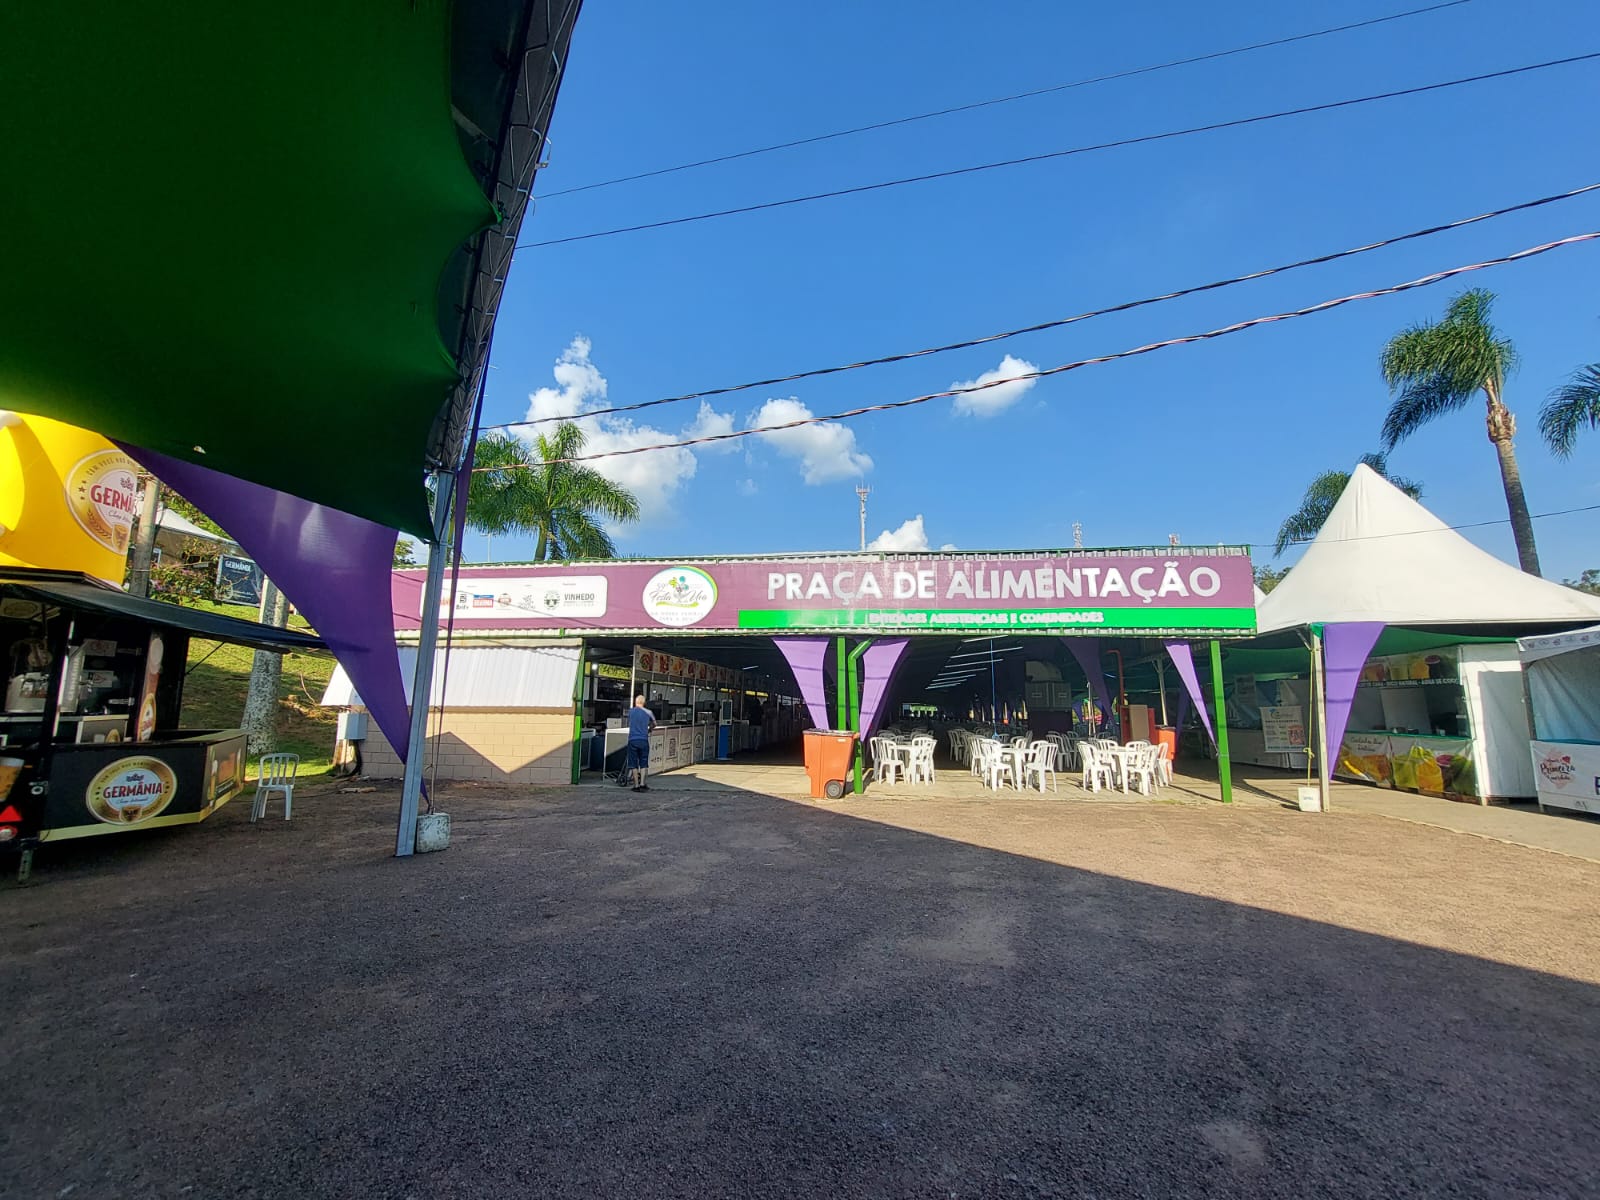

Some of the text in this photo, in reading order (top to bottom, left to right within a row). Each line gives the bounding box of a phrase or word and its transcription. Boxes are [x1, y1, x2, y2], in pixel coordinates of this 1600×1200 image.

[767, 561, 1221, 605] PRAÇA DE ALIMENTAÇÃO
[564, 593, 595, 601] VINHEDO
[103, 781, 163, 799] GERMÂNIA
